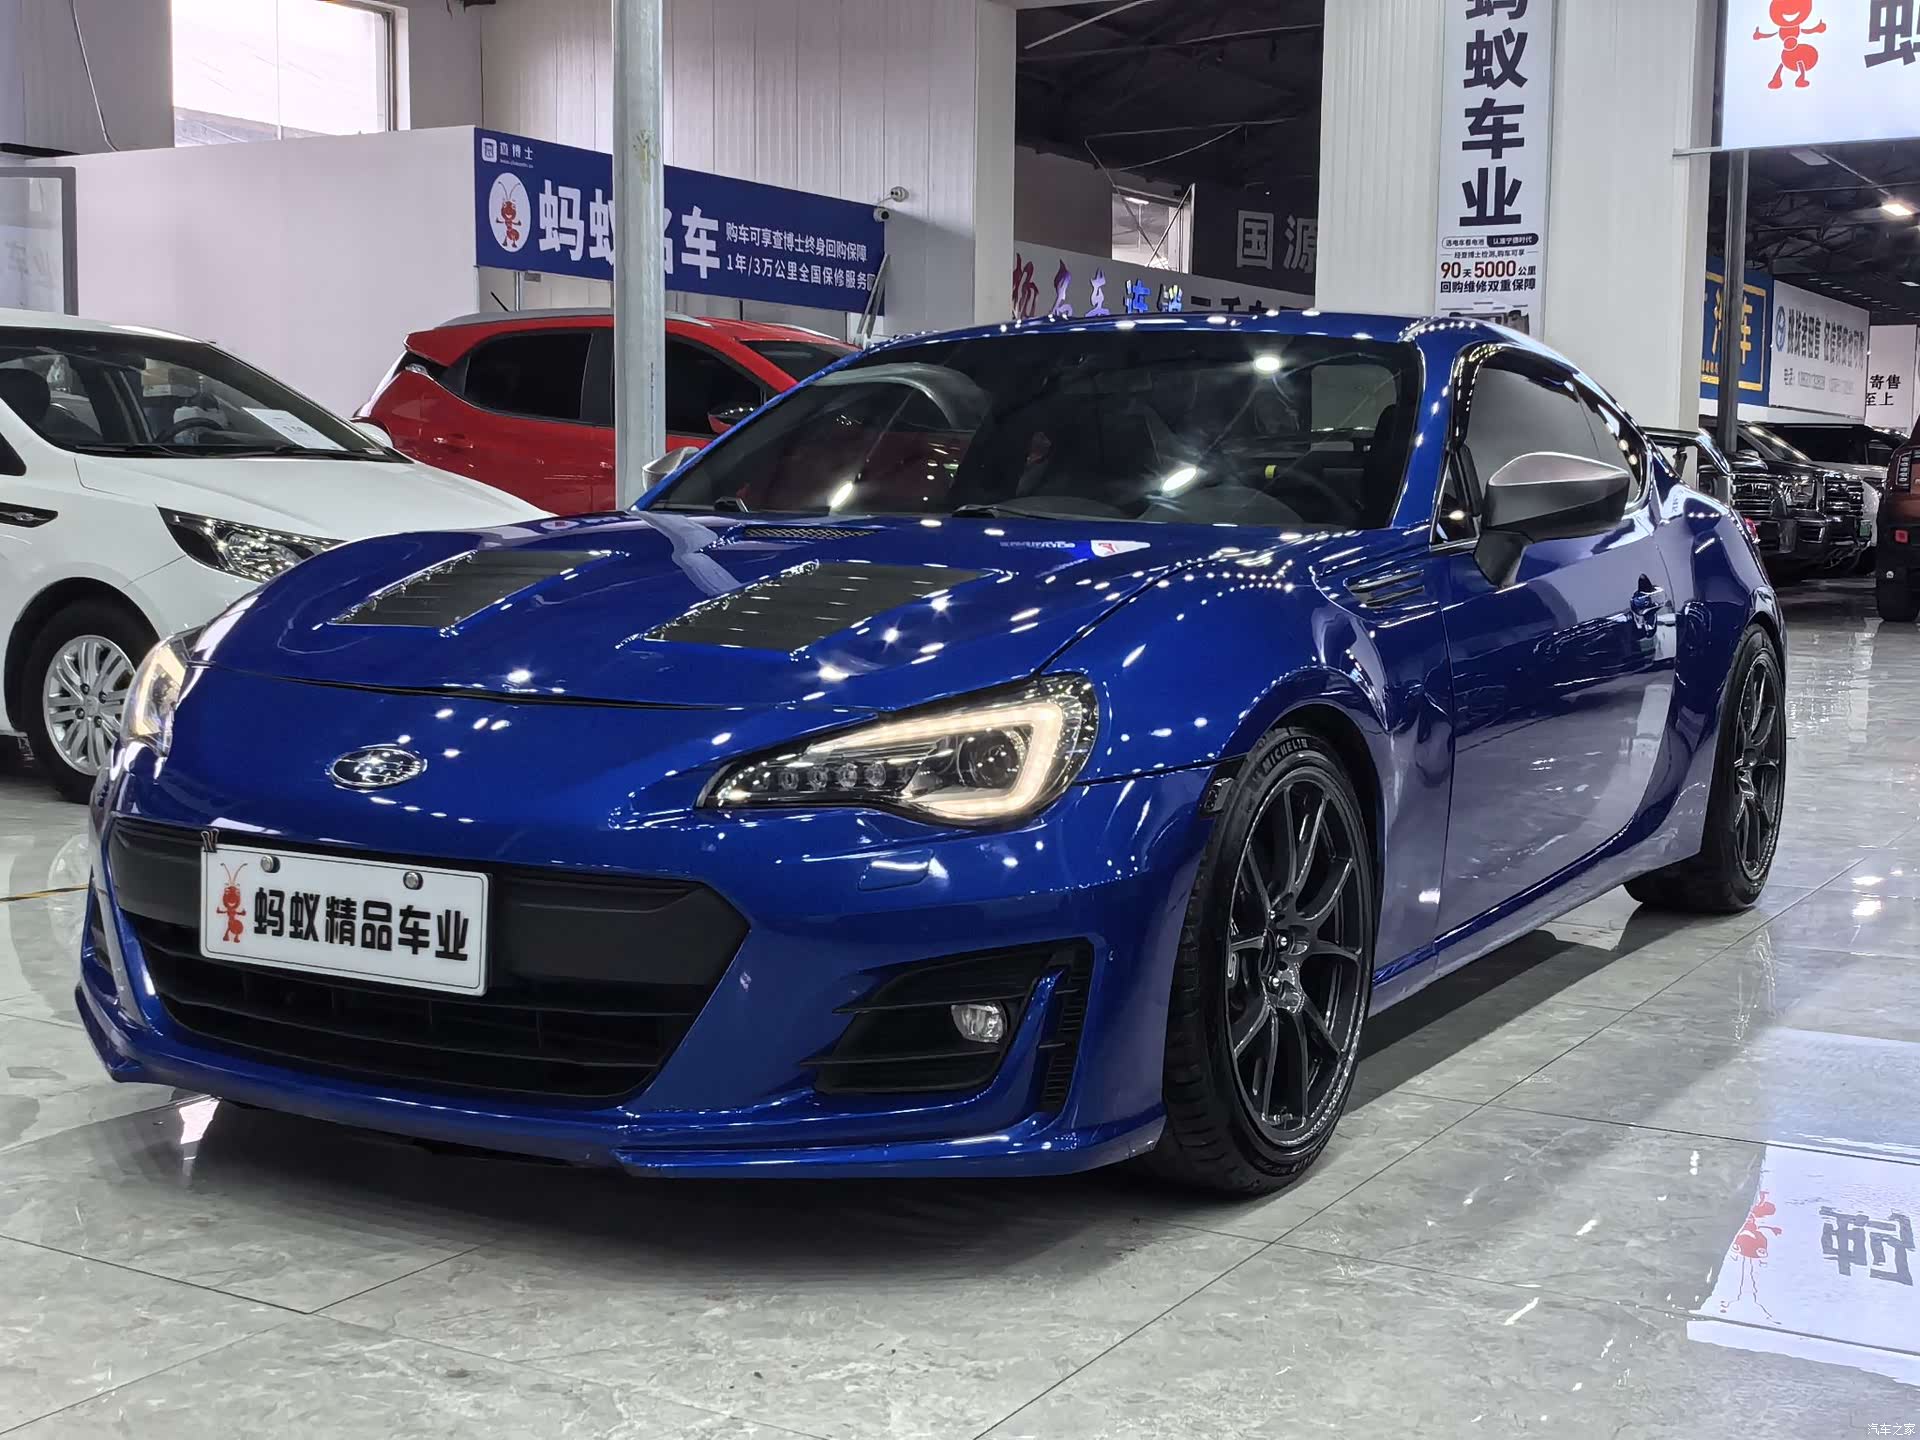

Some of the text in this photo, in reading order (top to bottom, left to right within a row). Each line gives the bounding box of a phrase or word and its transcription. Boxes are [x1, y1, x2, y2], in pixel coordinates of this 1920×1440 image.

[725, 222, 868, 263] 购车可享查博士终身回购保障
[1440, 278, 1536, 293] 回购维修双重保障
[1869, 374, 1902, 390] 寄售
[1261, 738, 1309, 774] MICHELIN
[253, 887, 469, 961] 蚂蚁精品车业
